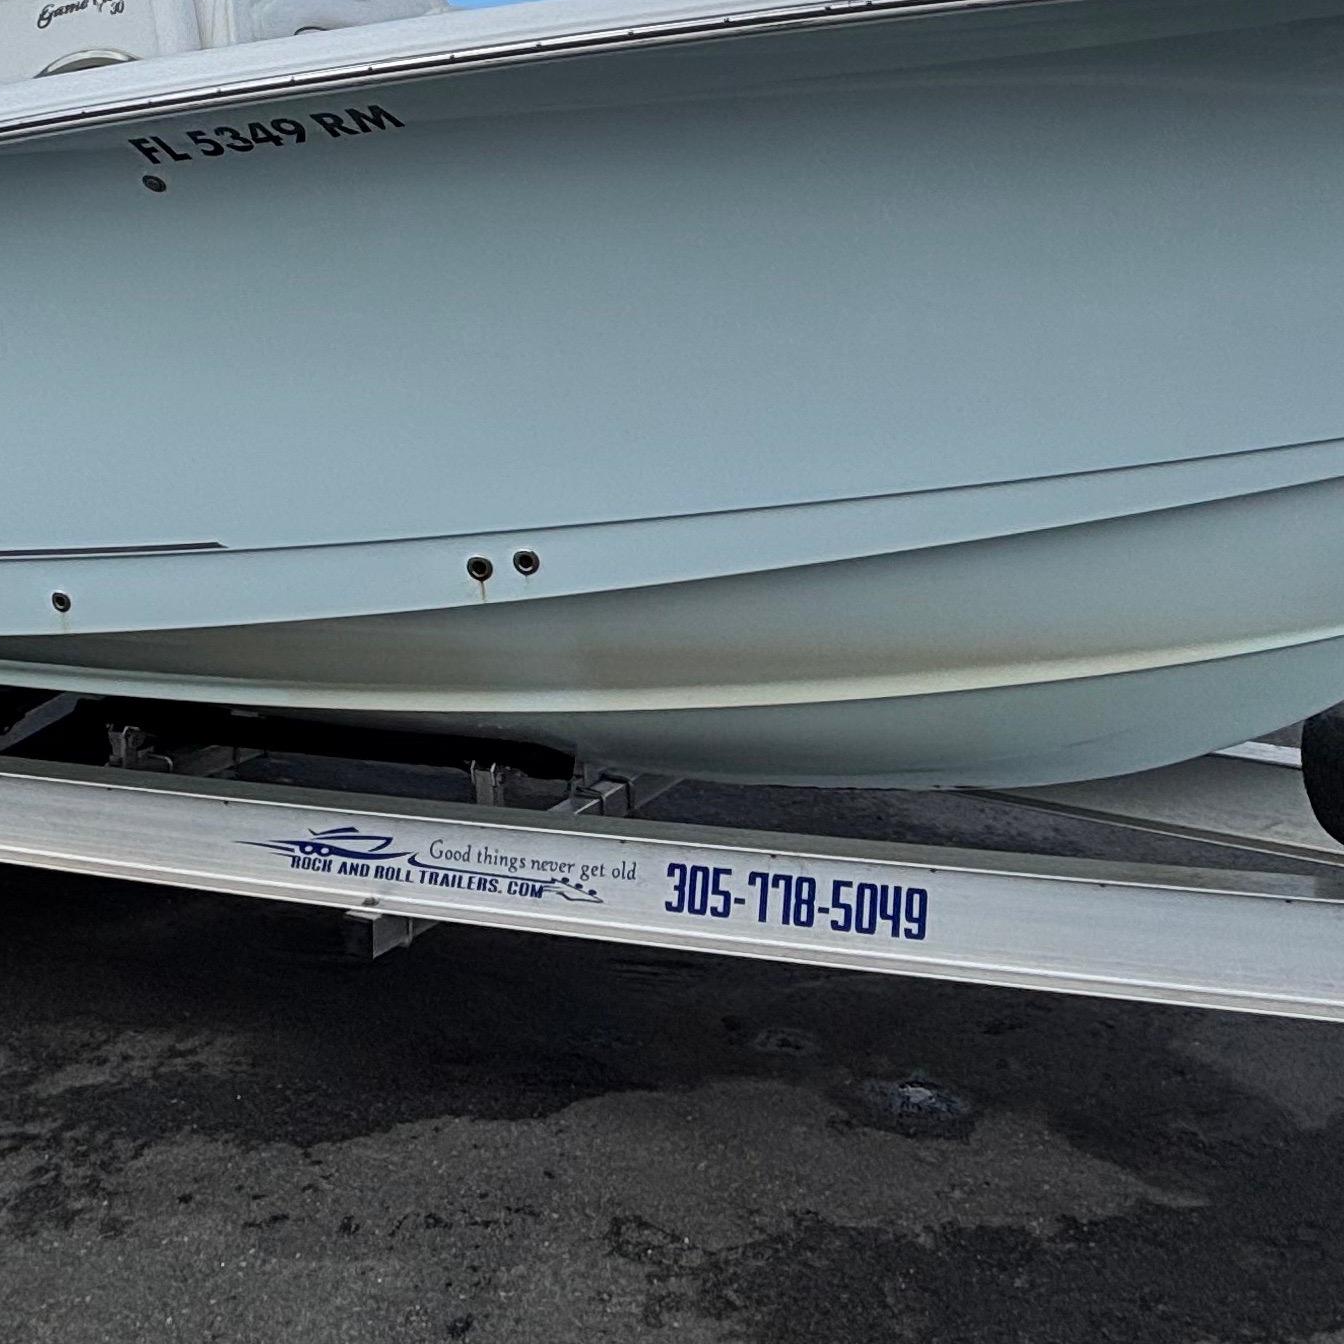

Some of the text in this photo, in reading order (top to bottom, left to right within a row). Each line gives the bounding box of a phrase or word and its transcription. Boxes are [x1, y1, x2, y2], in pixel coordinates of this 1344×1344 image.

[37, 0, 90, 29] Game
[128, 104, 406, 165] FL 5349 RM
[290, 855, 333, 873] ROCK
[337, 861, 370, 878] AND
[373, 865, 414, 884] ROLL
[429, 839, 637, 881] Good things never get old
[665, 862, 928, 941] 305-778-5049
